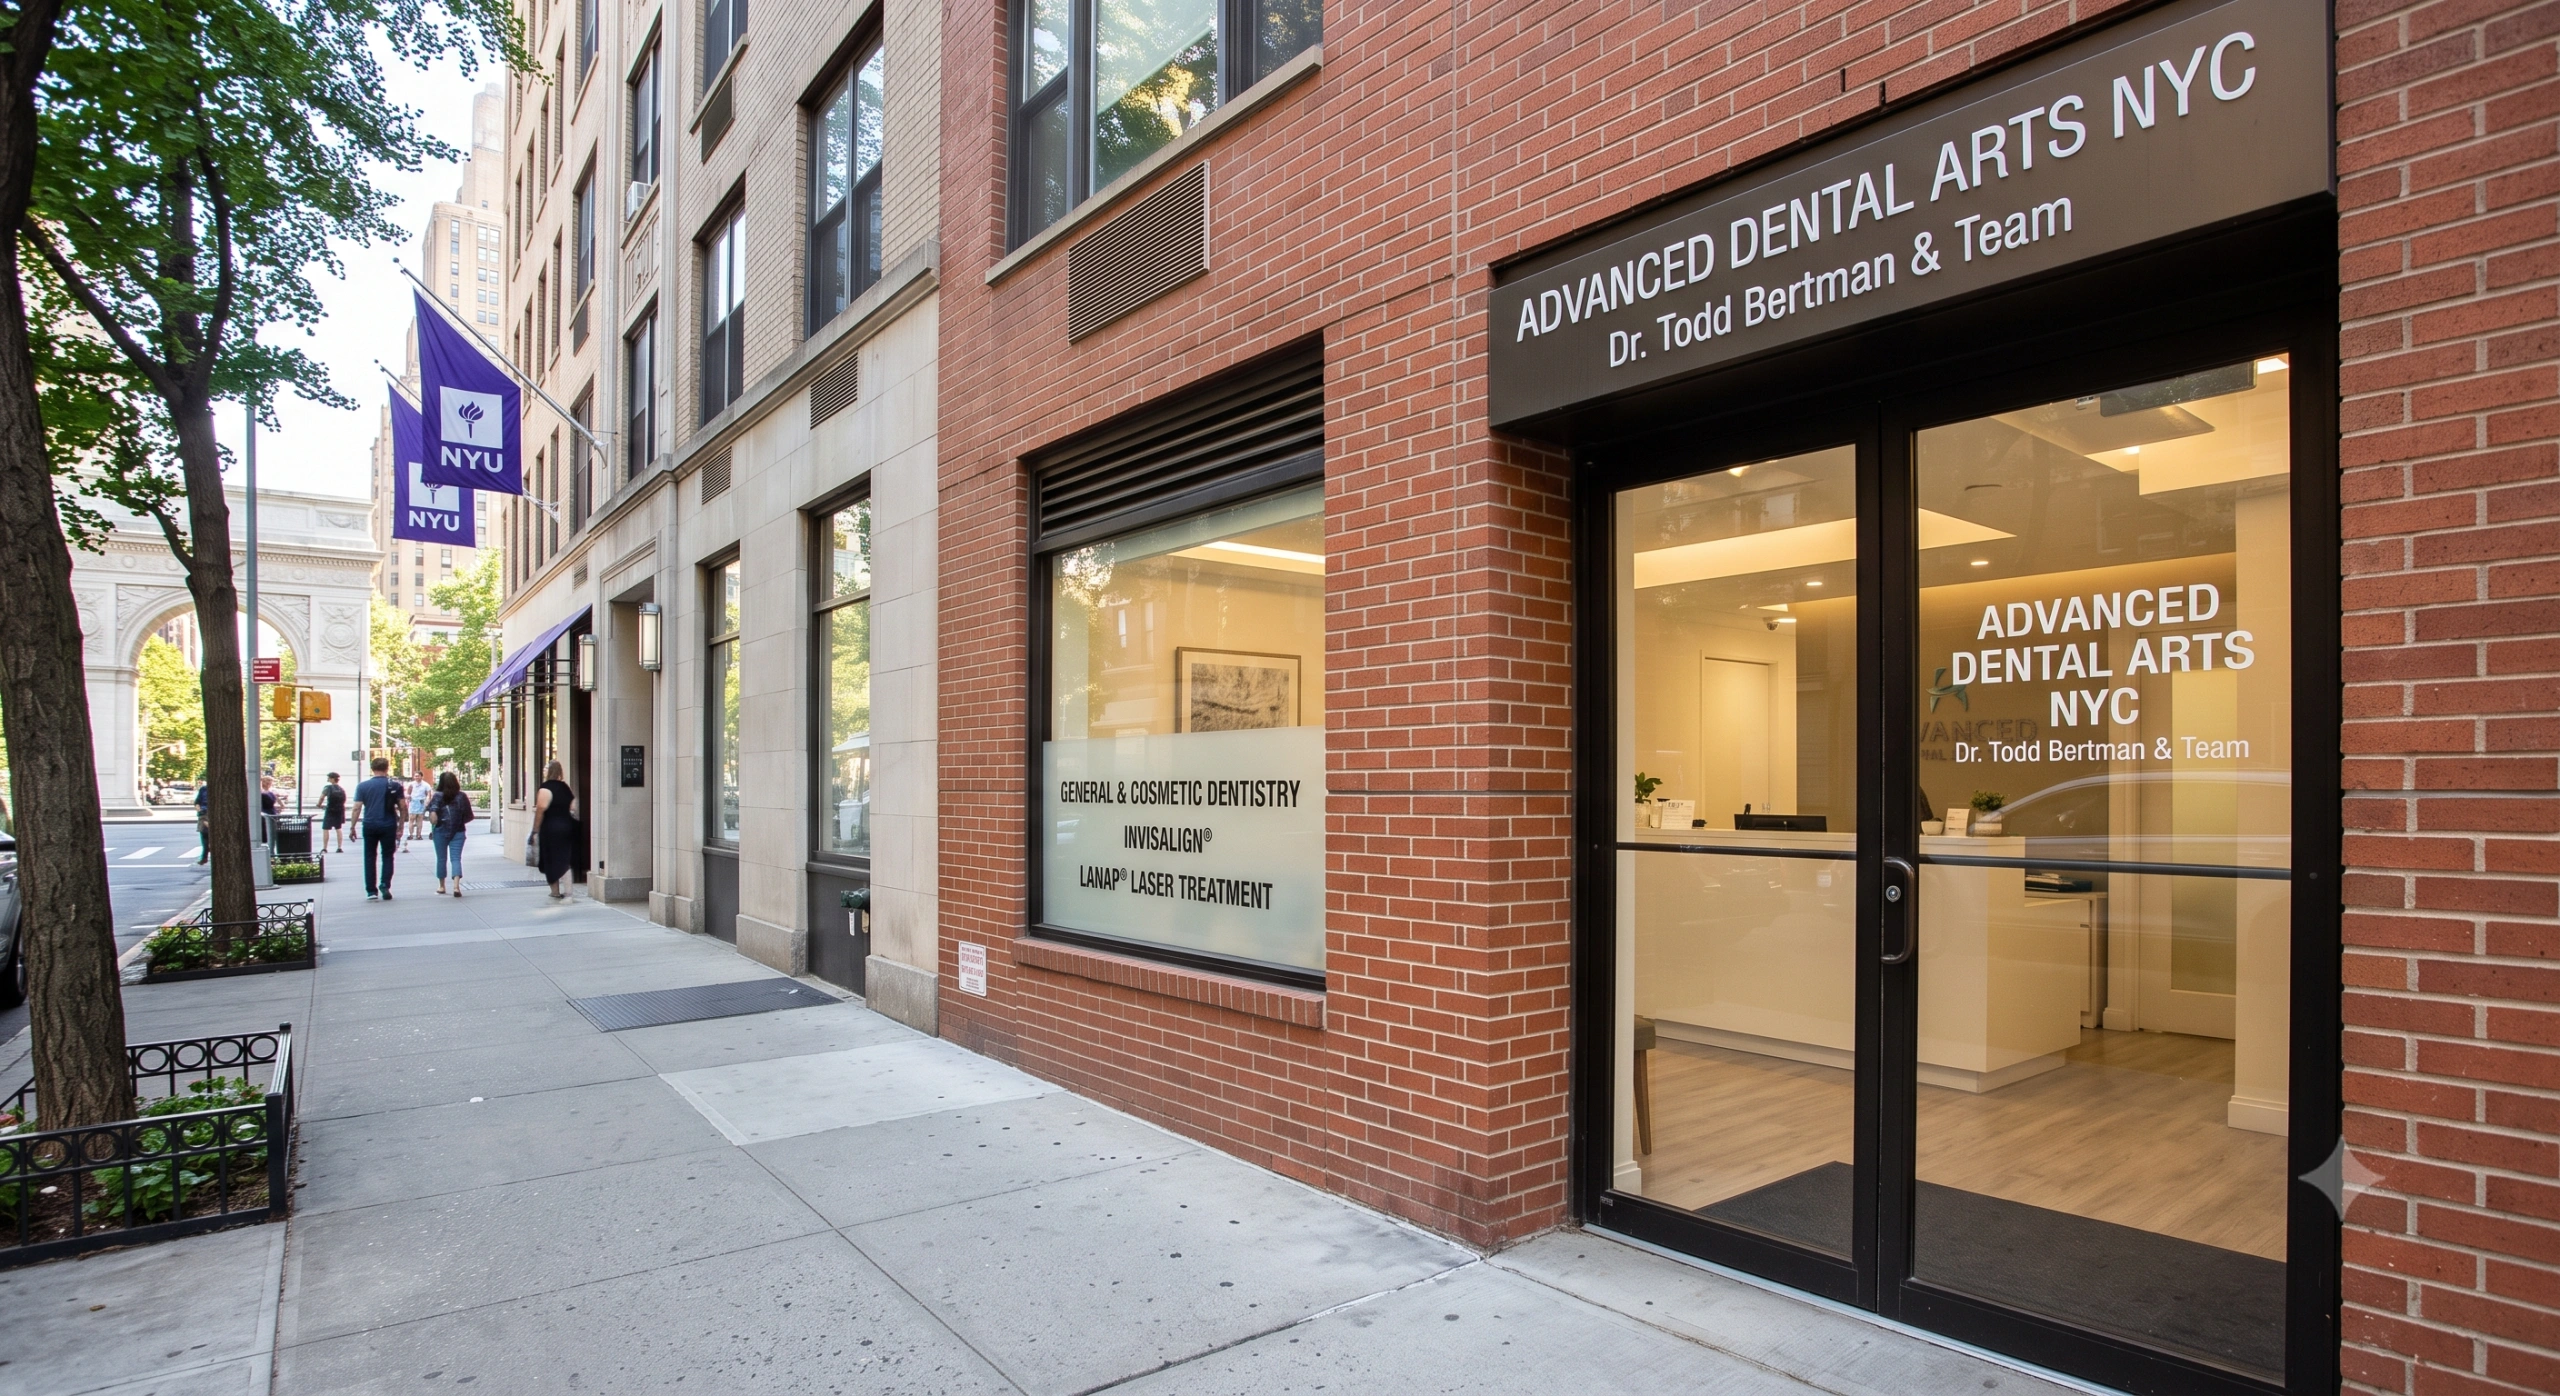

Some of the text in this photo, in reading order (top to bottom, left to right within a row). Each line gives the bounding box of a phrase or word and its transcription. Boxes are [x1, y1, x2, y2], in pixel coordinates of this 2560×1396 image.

[1516, 31, 2257, 342] ADVANCED DENTAL ARTS NYC
[1609, 197, 2072, 368] Dr. Todd Bertman & Team
[441, 446, 503, 473] NYU
[408, 510, 460, 532] NYU
[1977, 583, 2220, 640] ADVANCED
[1952, 630, 2255, 686] DENTAL ARTS
[2050, 687, 2139, 727] NYC
[1955, 742, 1982, 762] Dr.
[1988, 740, 2040, 763] Todd
[2049, 740, 2145, 762] Bertman
[2154, 737, 2172, 760] &
[2180, 736, 2250, 759] Team
[1060, 779, 1301, 808] GENERAL & COSMETIC DENTISTRY
[1131, 870, 1174, 898] LASER
[1178, 874, 1273, 910] TREATMENT
